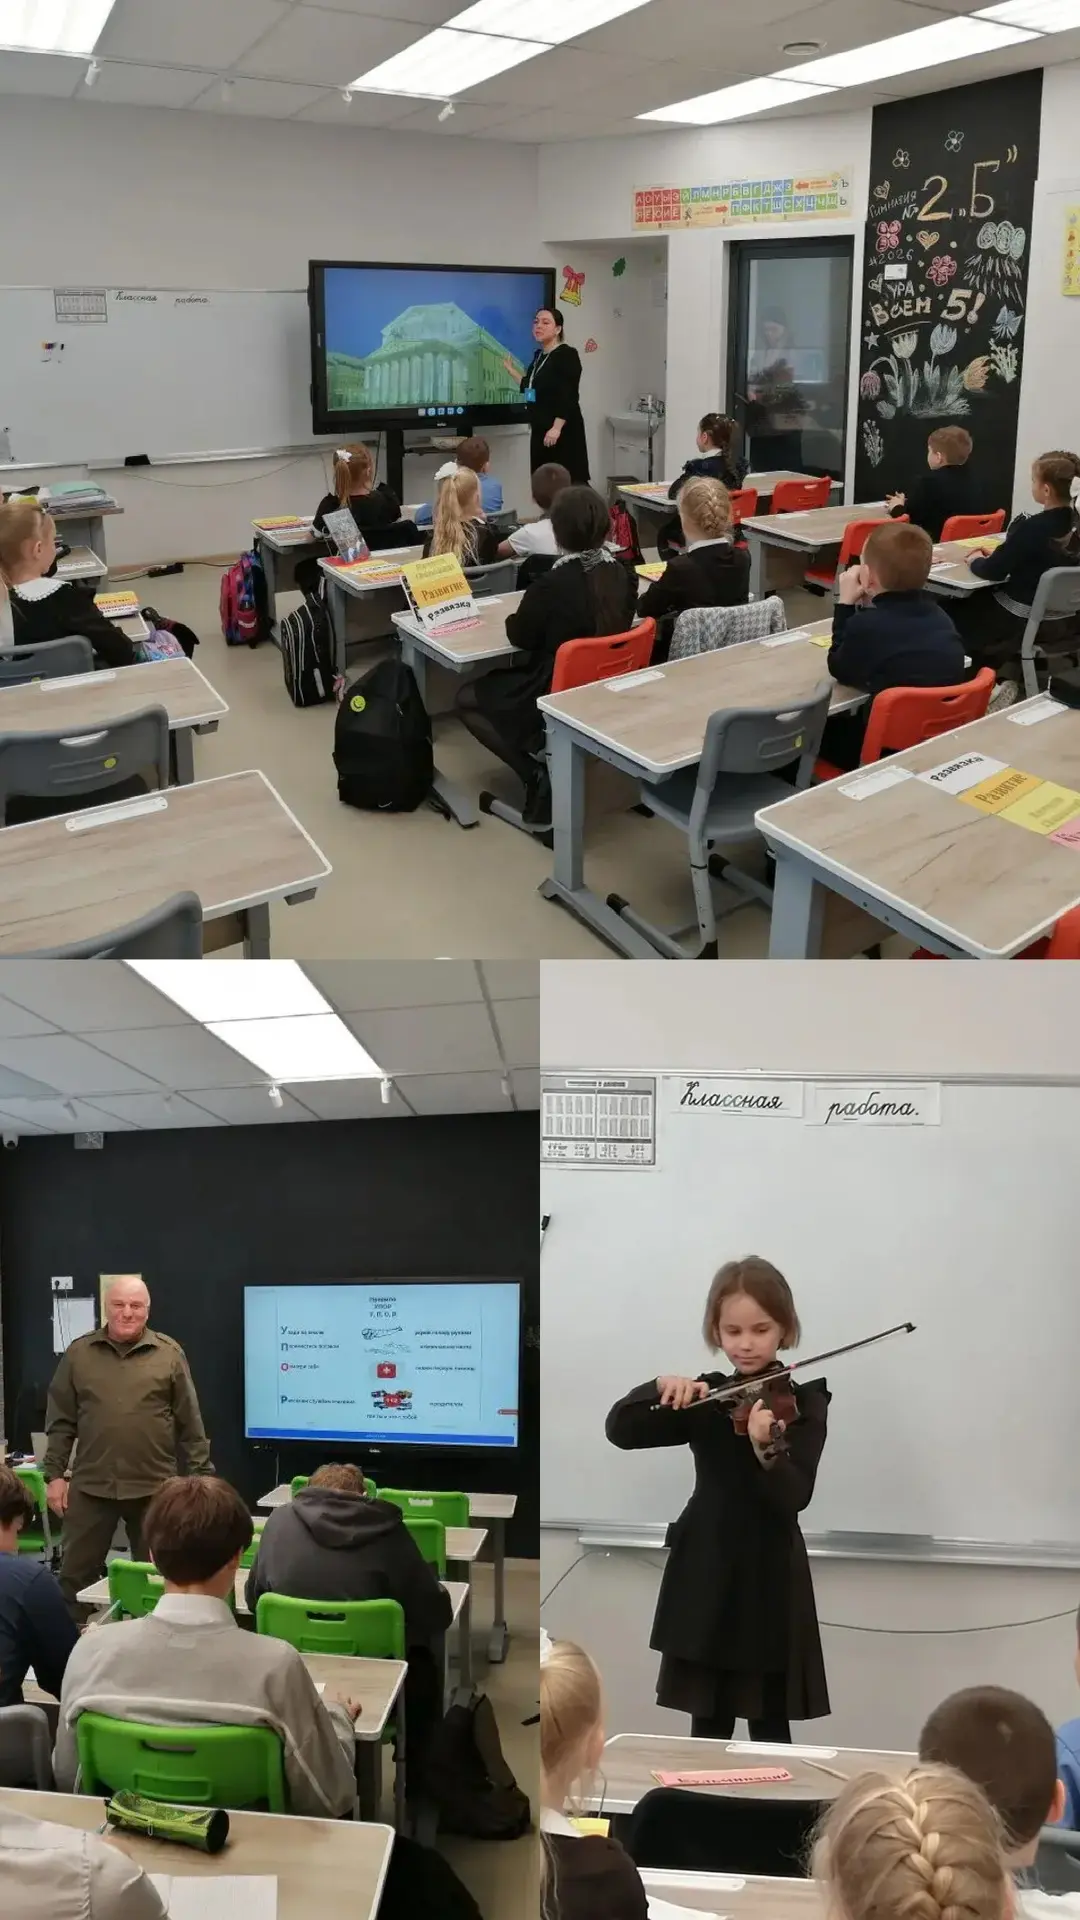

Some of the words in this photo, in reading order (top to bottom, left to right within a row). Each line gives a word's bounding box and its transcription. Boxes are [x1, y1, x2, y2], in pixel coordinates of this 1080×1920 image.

[917, 175, 952, 221] 2
[886, 280, 915, 299] УРА
[680, 1081, 783, 1109] Классная
[824, 1091, 920, 1125] работа.
